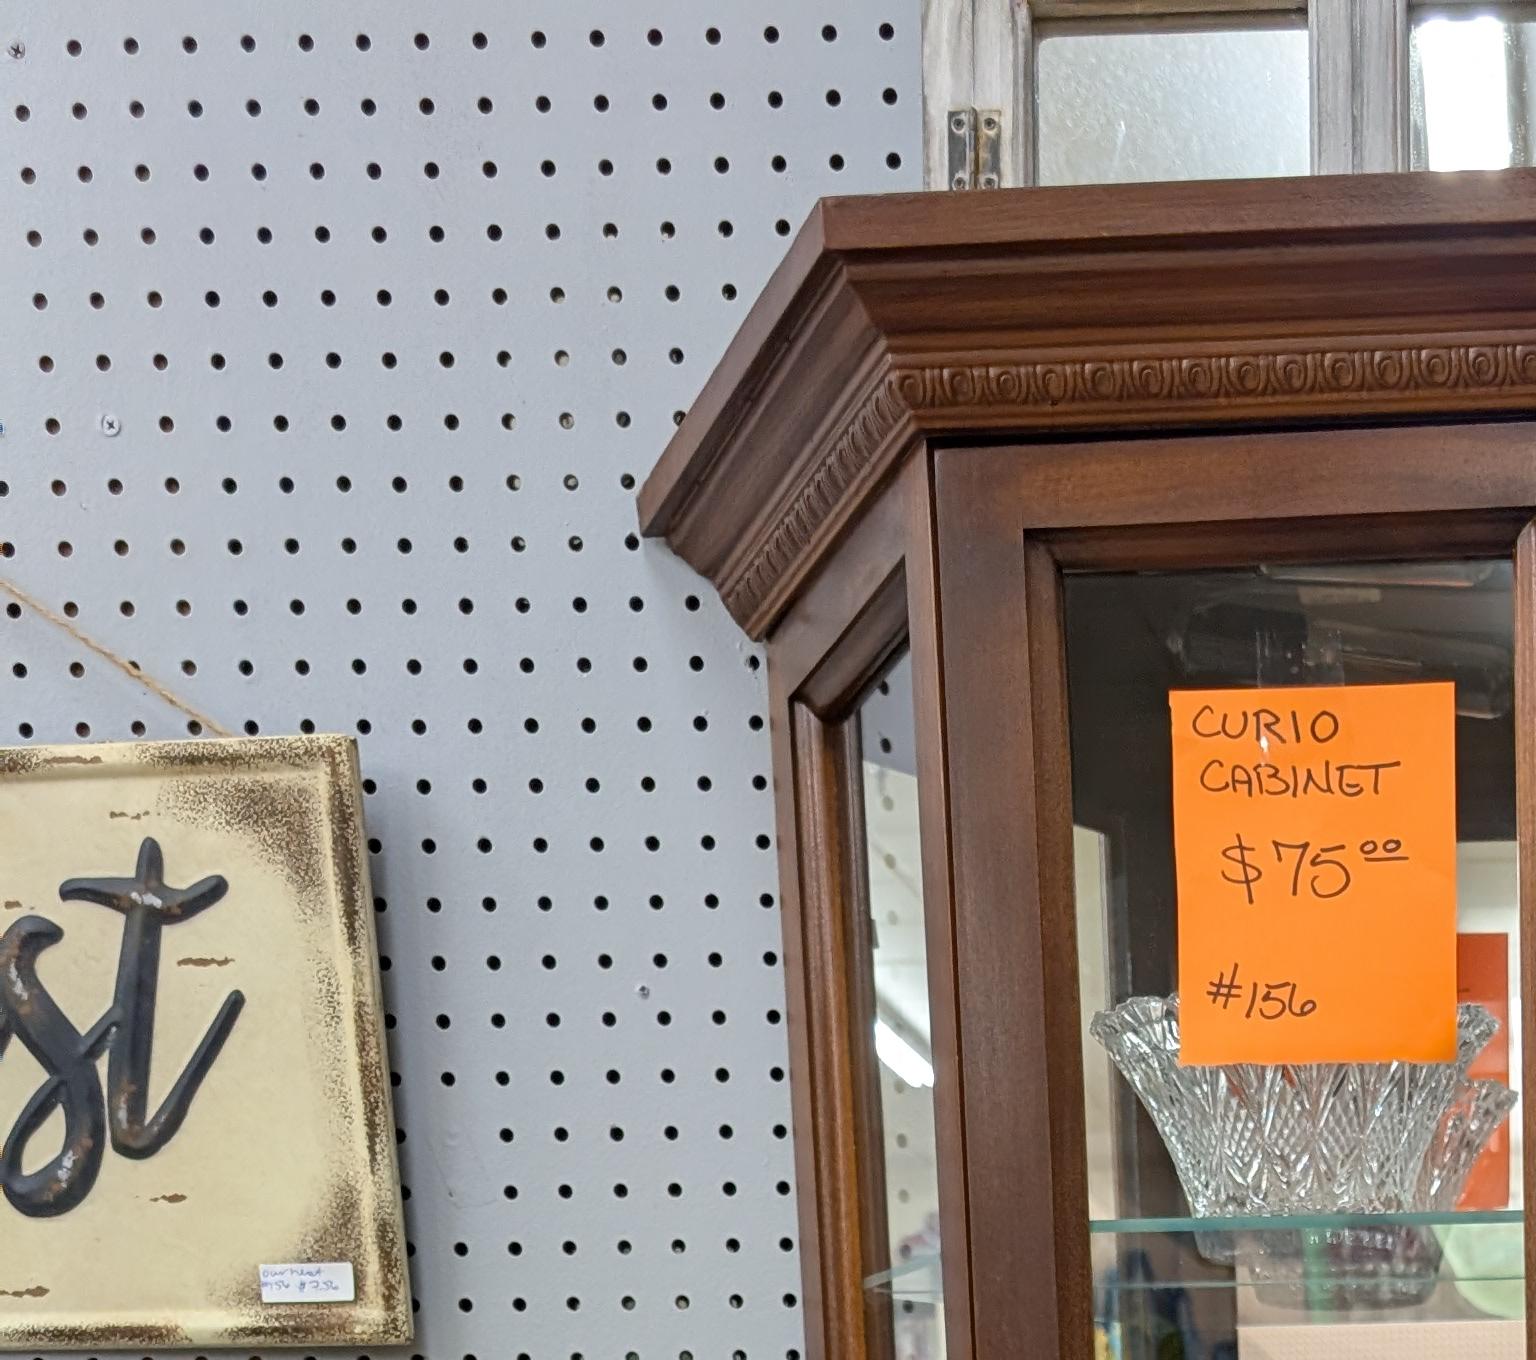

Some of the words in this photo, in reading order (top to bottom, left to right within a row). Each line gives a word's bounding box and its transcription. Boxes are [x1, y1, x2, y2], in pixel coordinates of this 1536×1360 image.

[1191, 704, 1340, 744] CURIO
[1200, 760, 1401, 798] CABINET
[1206, 963, 1317, 1020] #156
